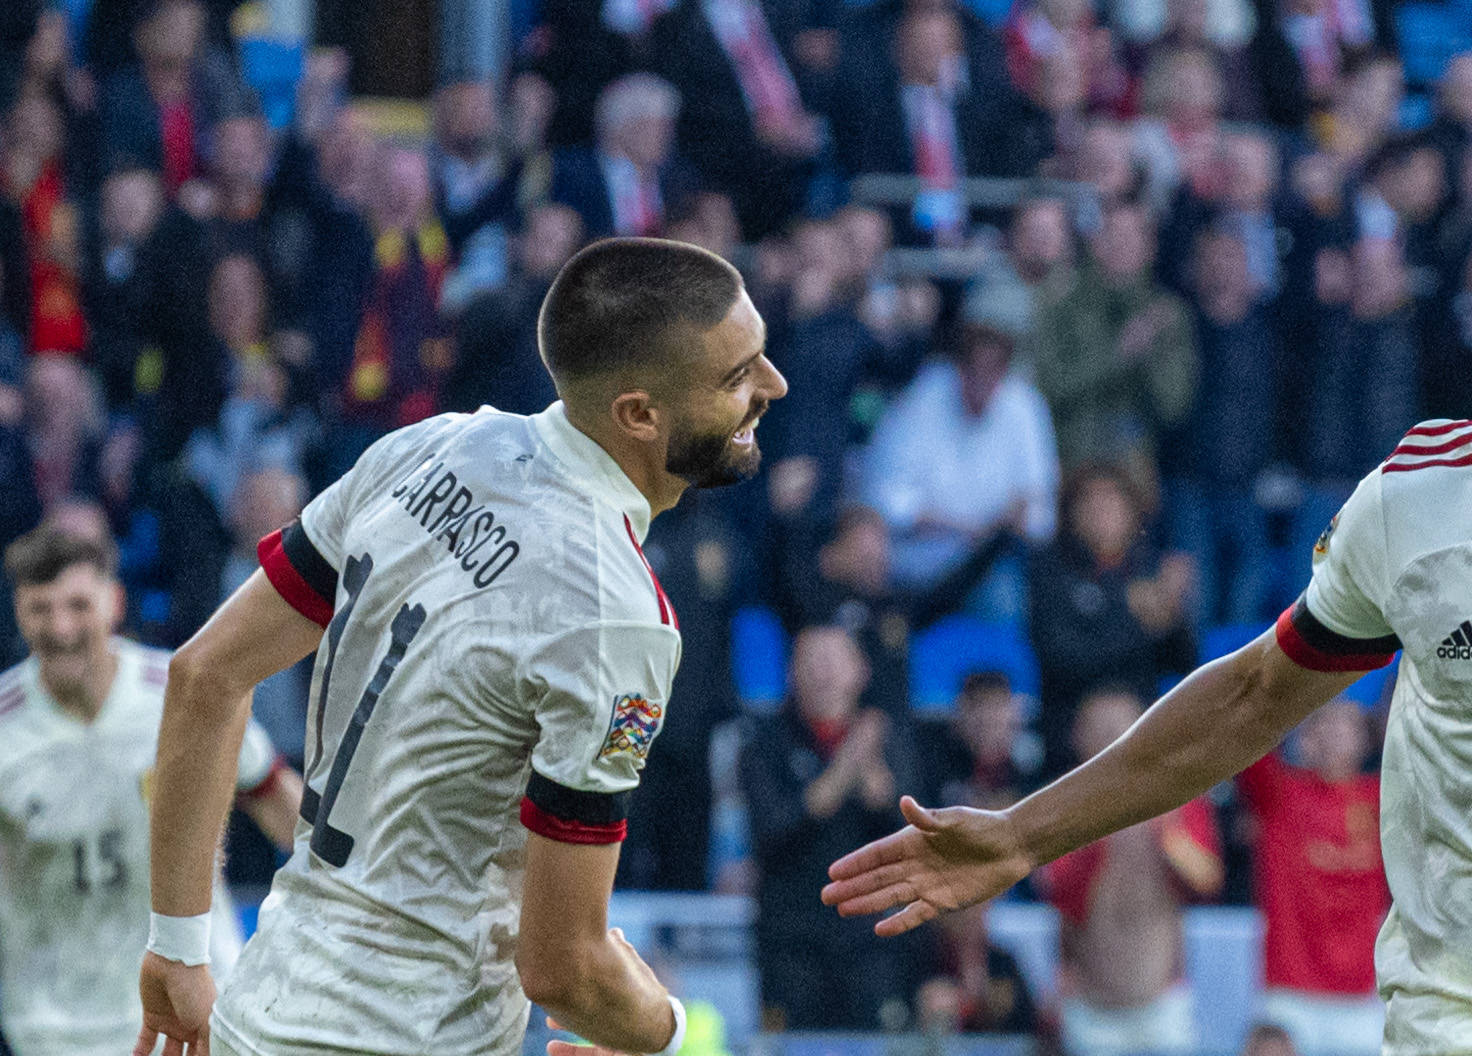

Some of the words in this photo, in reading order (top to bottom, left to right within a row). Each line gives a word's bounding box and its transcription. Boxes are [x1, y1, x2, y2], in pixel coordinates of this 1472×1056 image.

[392, 453, 520, 589] CARRASCO
[300, 552, 427, 868] 11
[72, 828, 129, 897] 15
